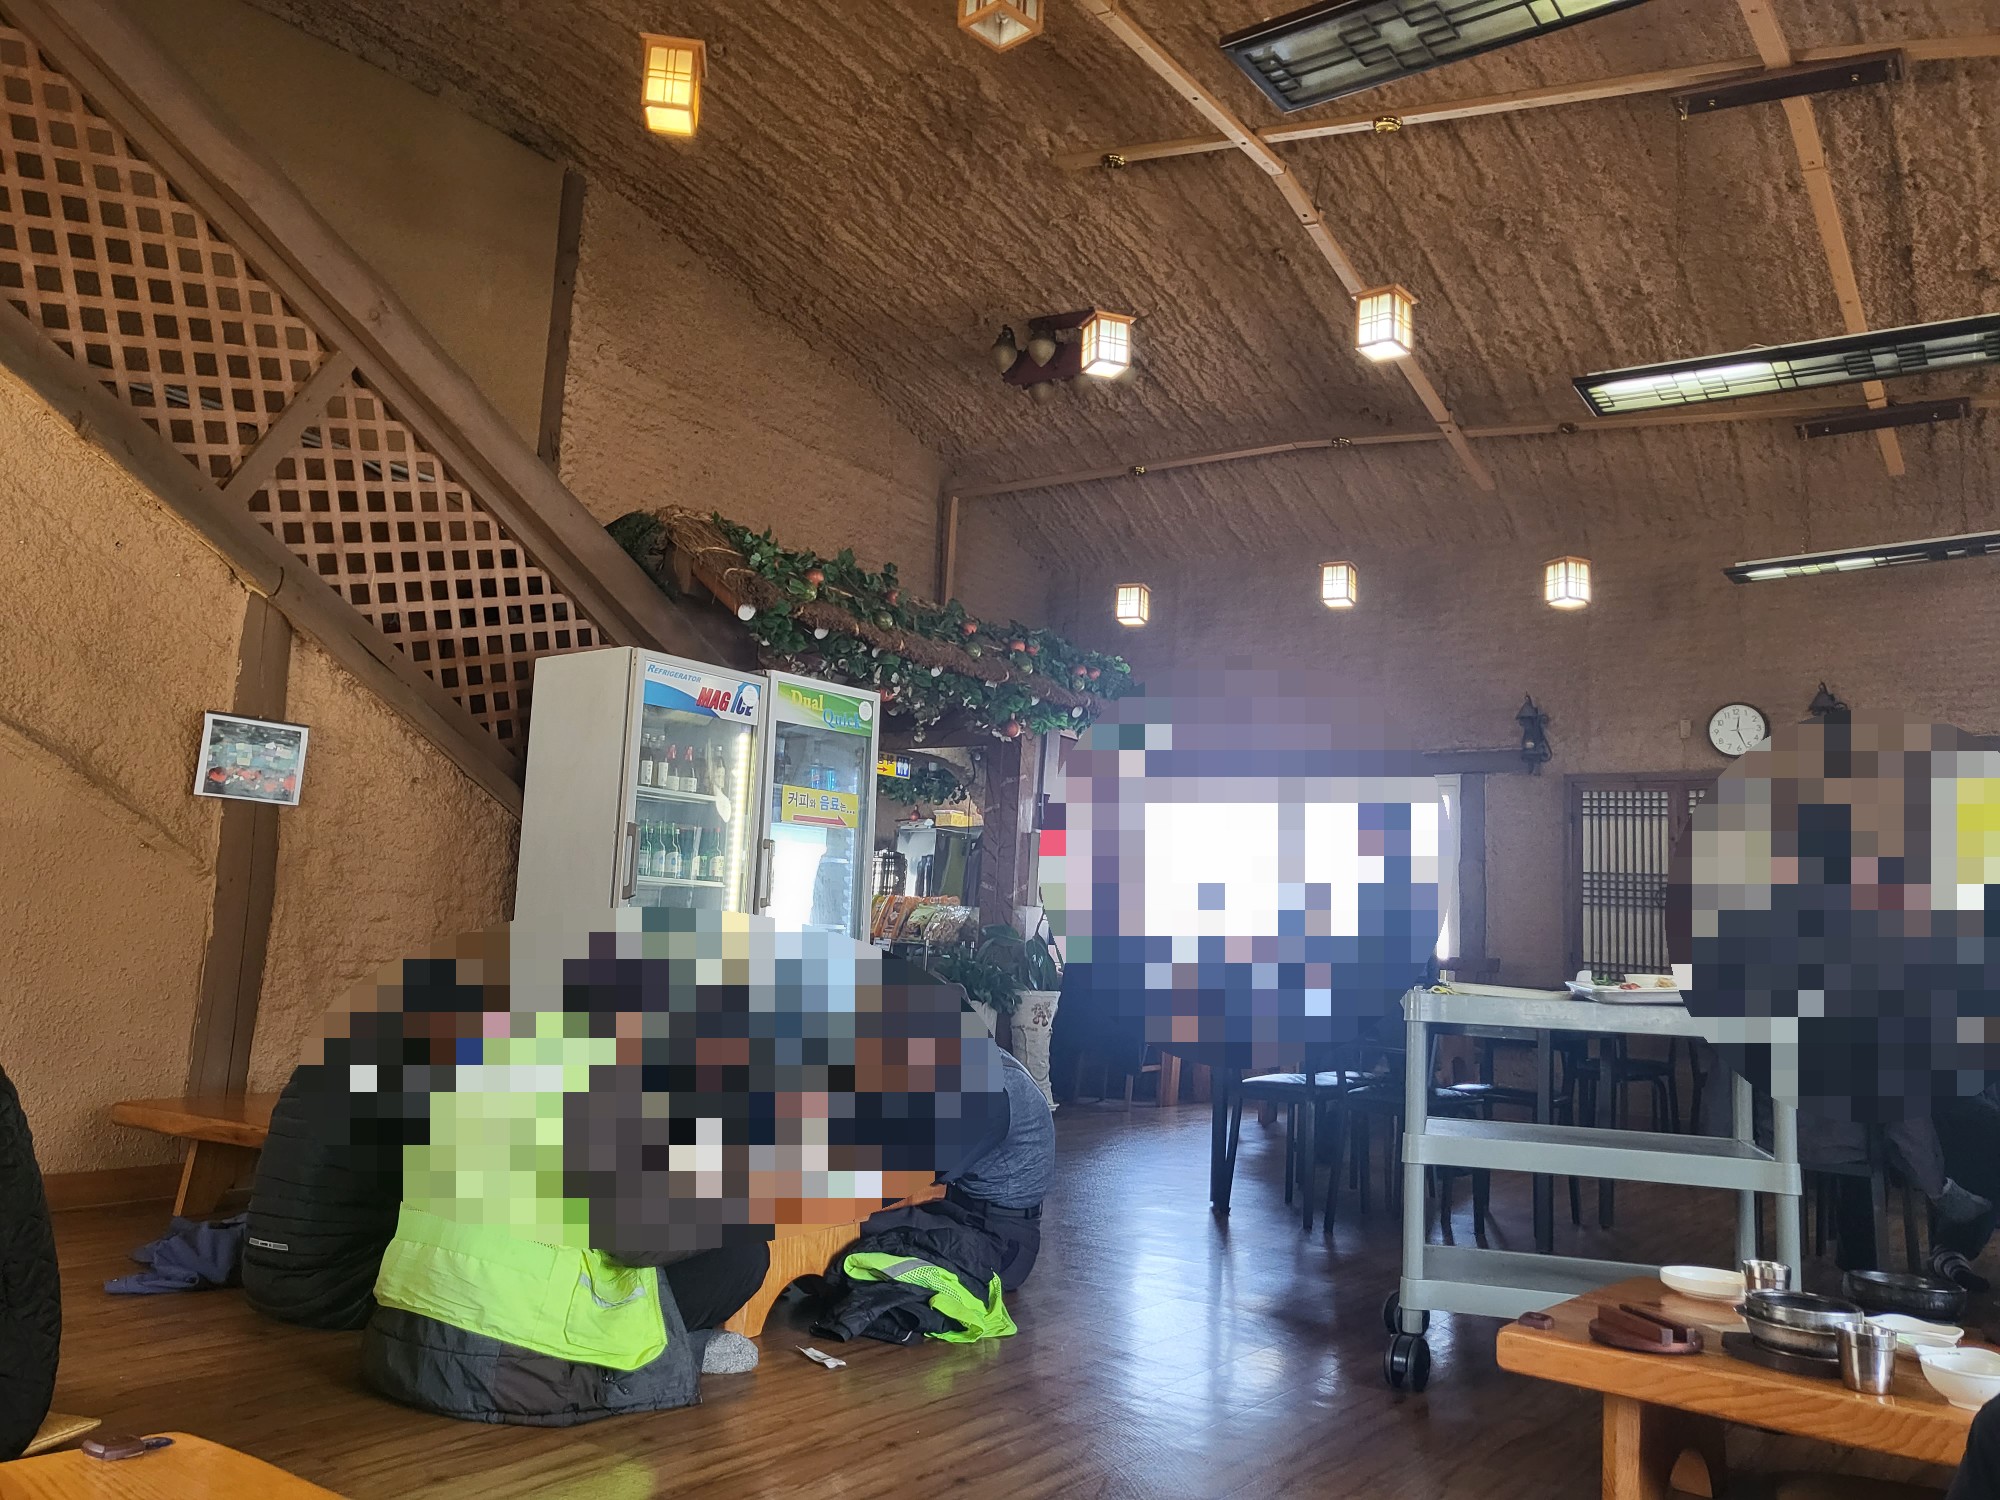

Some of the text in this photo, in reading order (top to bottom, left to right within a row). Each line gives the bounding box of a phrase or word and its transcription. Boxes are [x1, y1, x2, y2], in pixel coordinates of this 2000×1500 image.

[696, 686, 731, 712] MAG
[791, 689, 824, 712] Dual
[823, 708, 862, 729] Quick
[788, 792, 816, 809] 커피와
